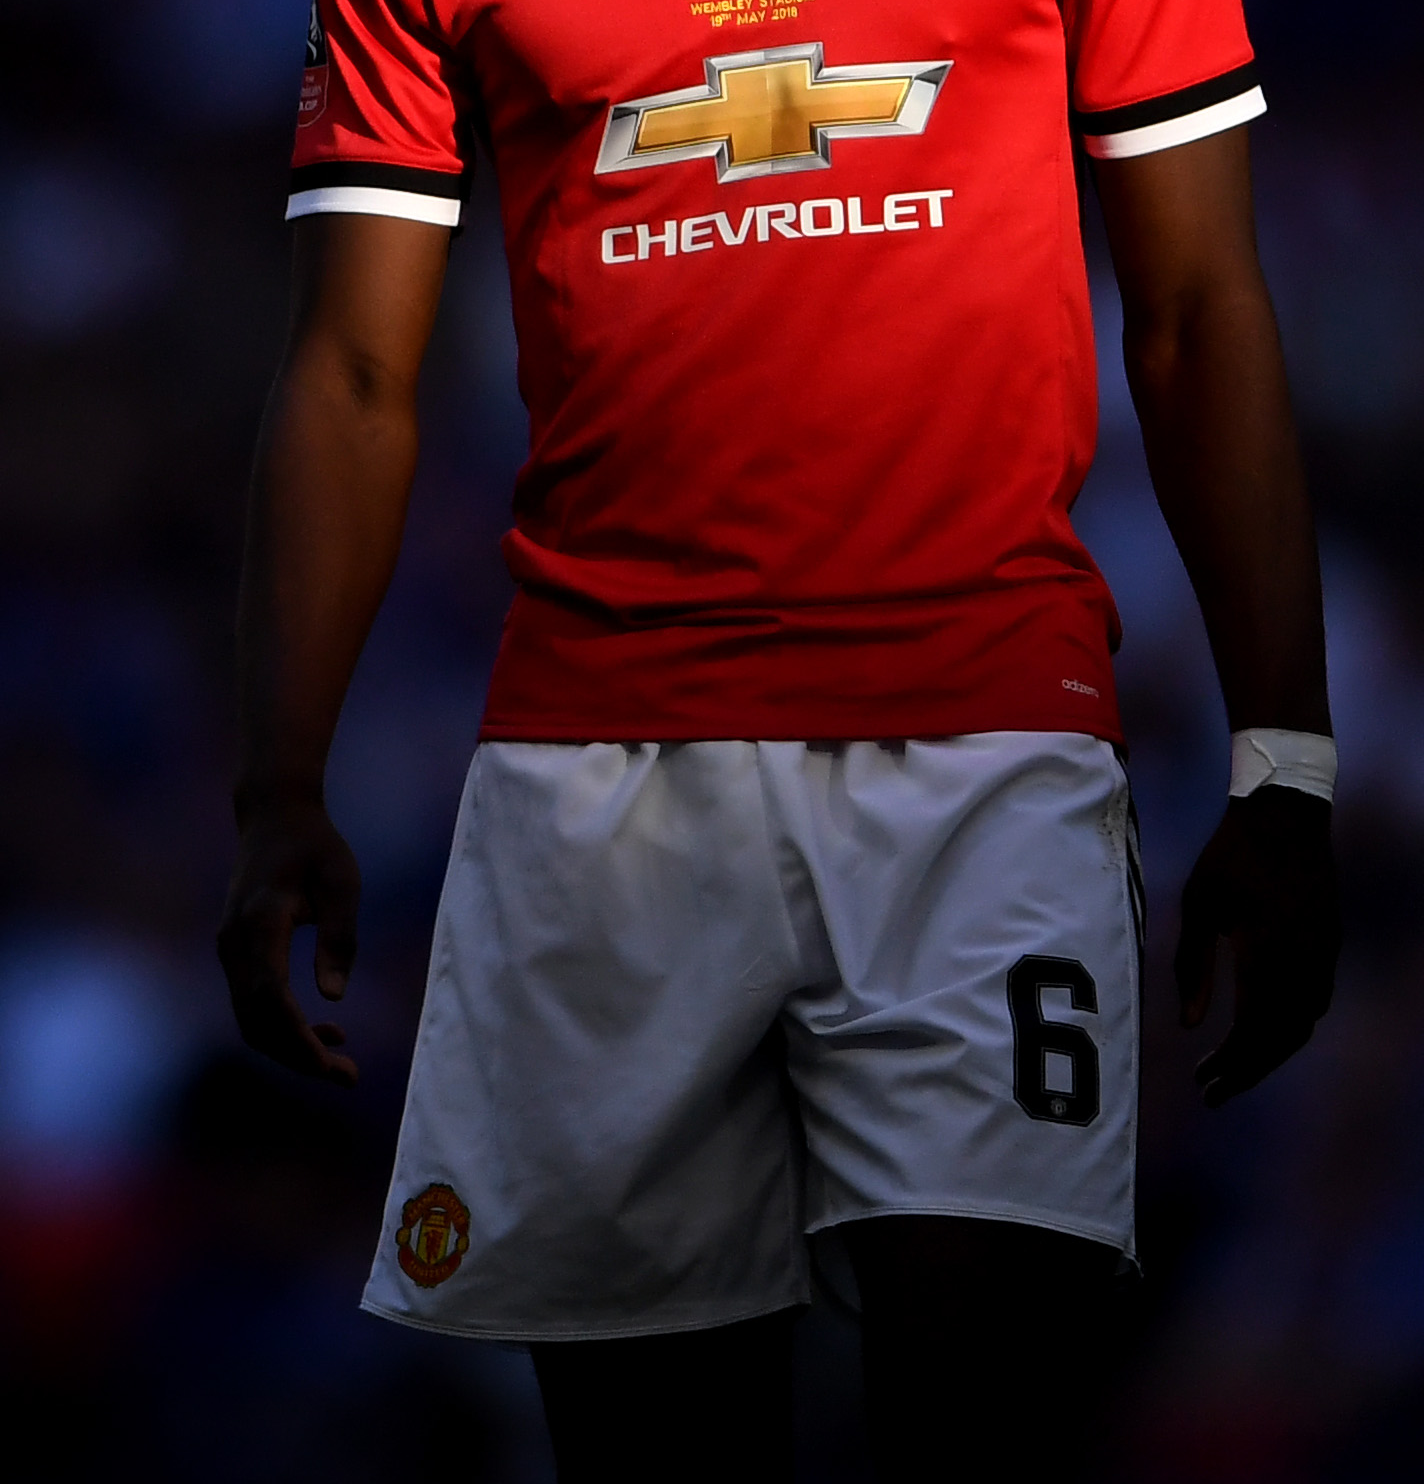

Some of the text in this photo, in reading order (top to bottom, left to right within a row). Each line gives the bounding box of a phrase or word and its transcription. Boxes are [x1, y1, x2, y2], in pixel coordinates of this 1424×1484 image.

[736, 10, 766, 25] MAY
[771, 6, 798, 20] 2018
[601, 188, 954, 264] CHEVROLET
[1007, 954, 1100, 1127] 6
